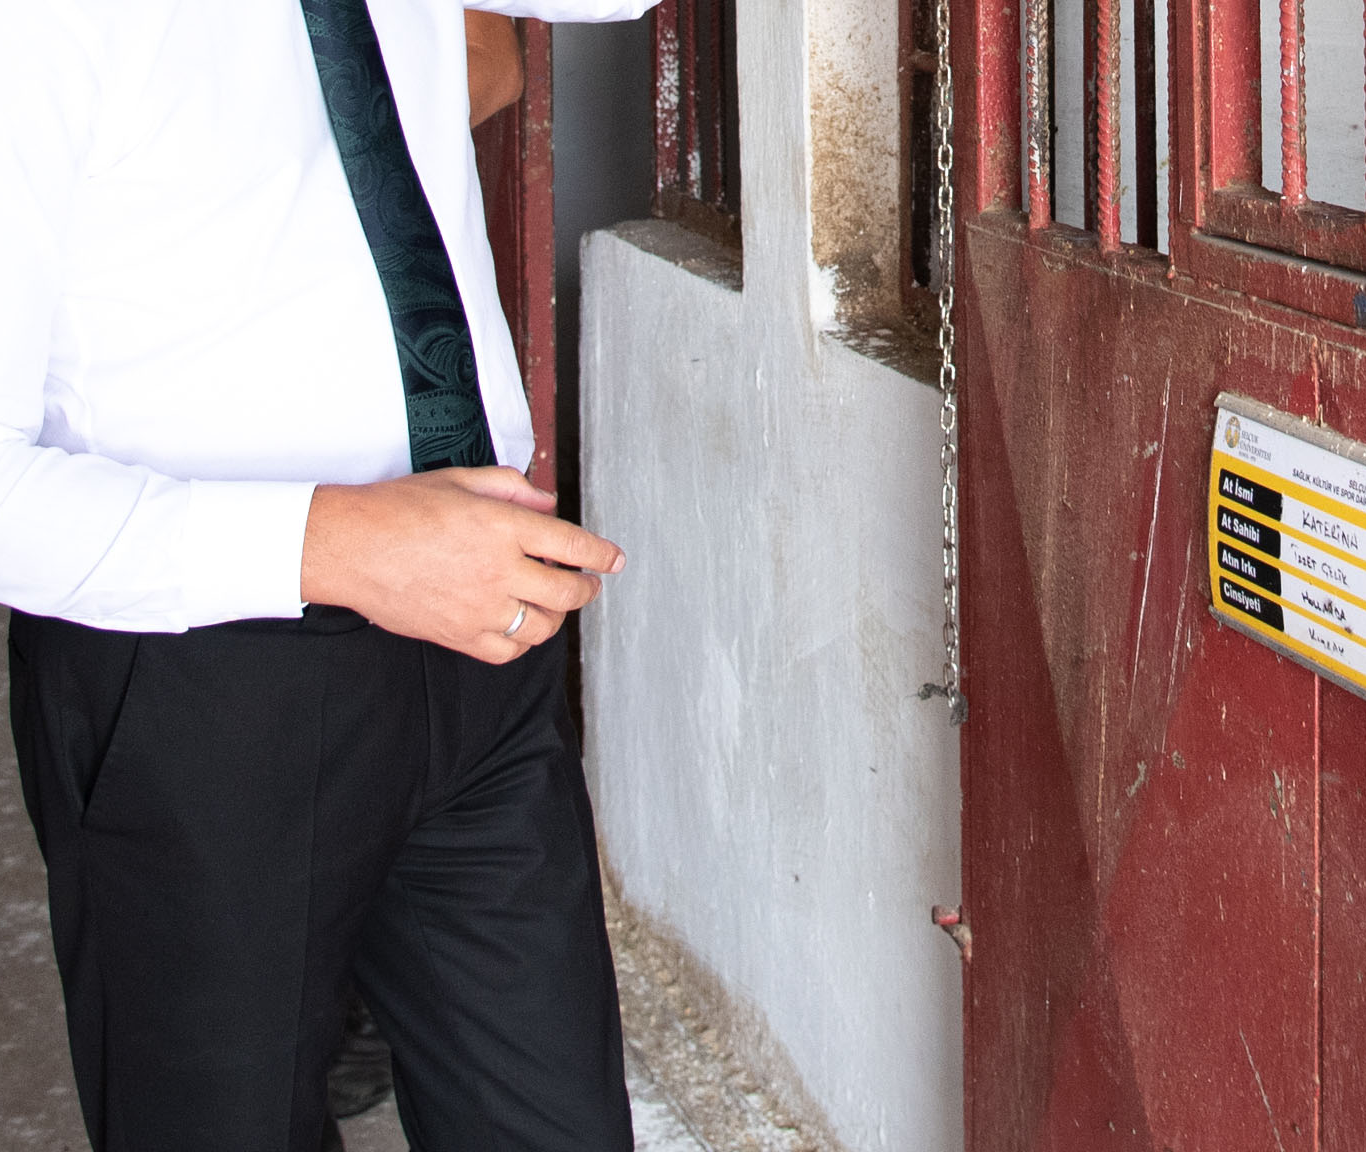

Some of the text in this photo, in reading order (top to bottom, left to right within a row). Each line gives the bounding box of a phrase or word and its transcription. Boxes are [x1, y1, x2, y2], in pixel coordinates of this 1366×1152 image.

[1223, 477, 1254, 504] At İsmi
[1312, 476, 1332, 491] KÜLTÜR
[1333, 486, 1340, 495] VE
[1340, 489, 1355, 501] SPOR
[1221, 513, 1260, 544] At Sahibi
[1222, 549, 1257, 579] Atın Irkı
[1223, 582, 1261, 614] Cinsiyeti
